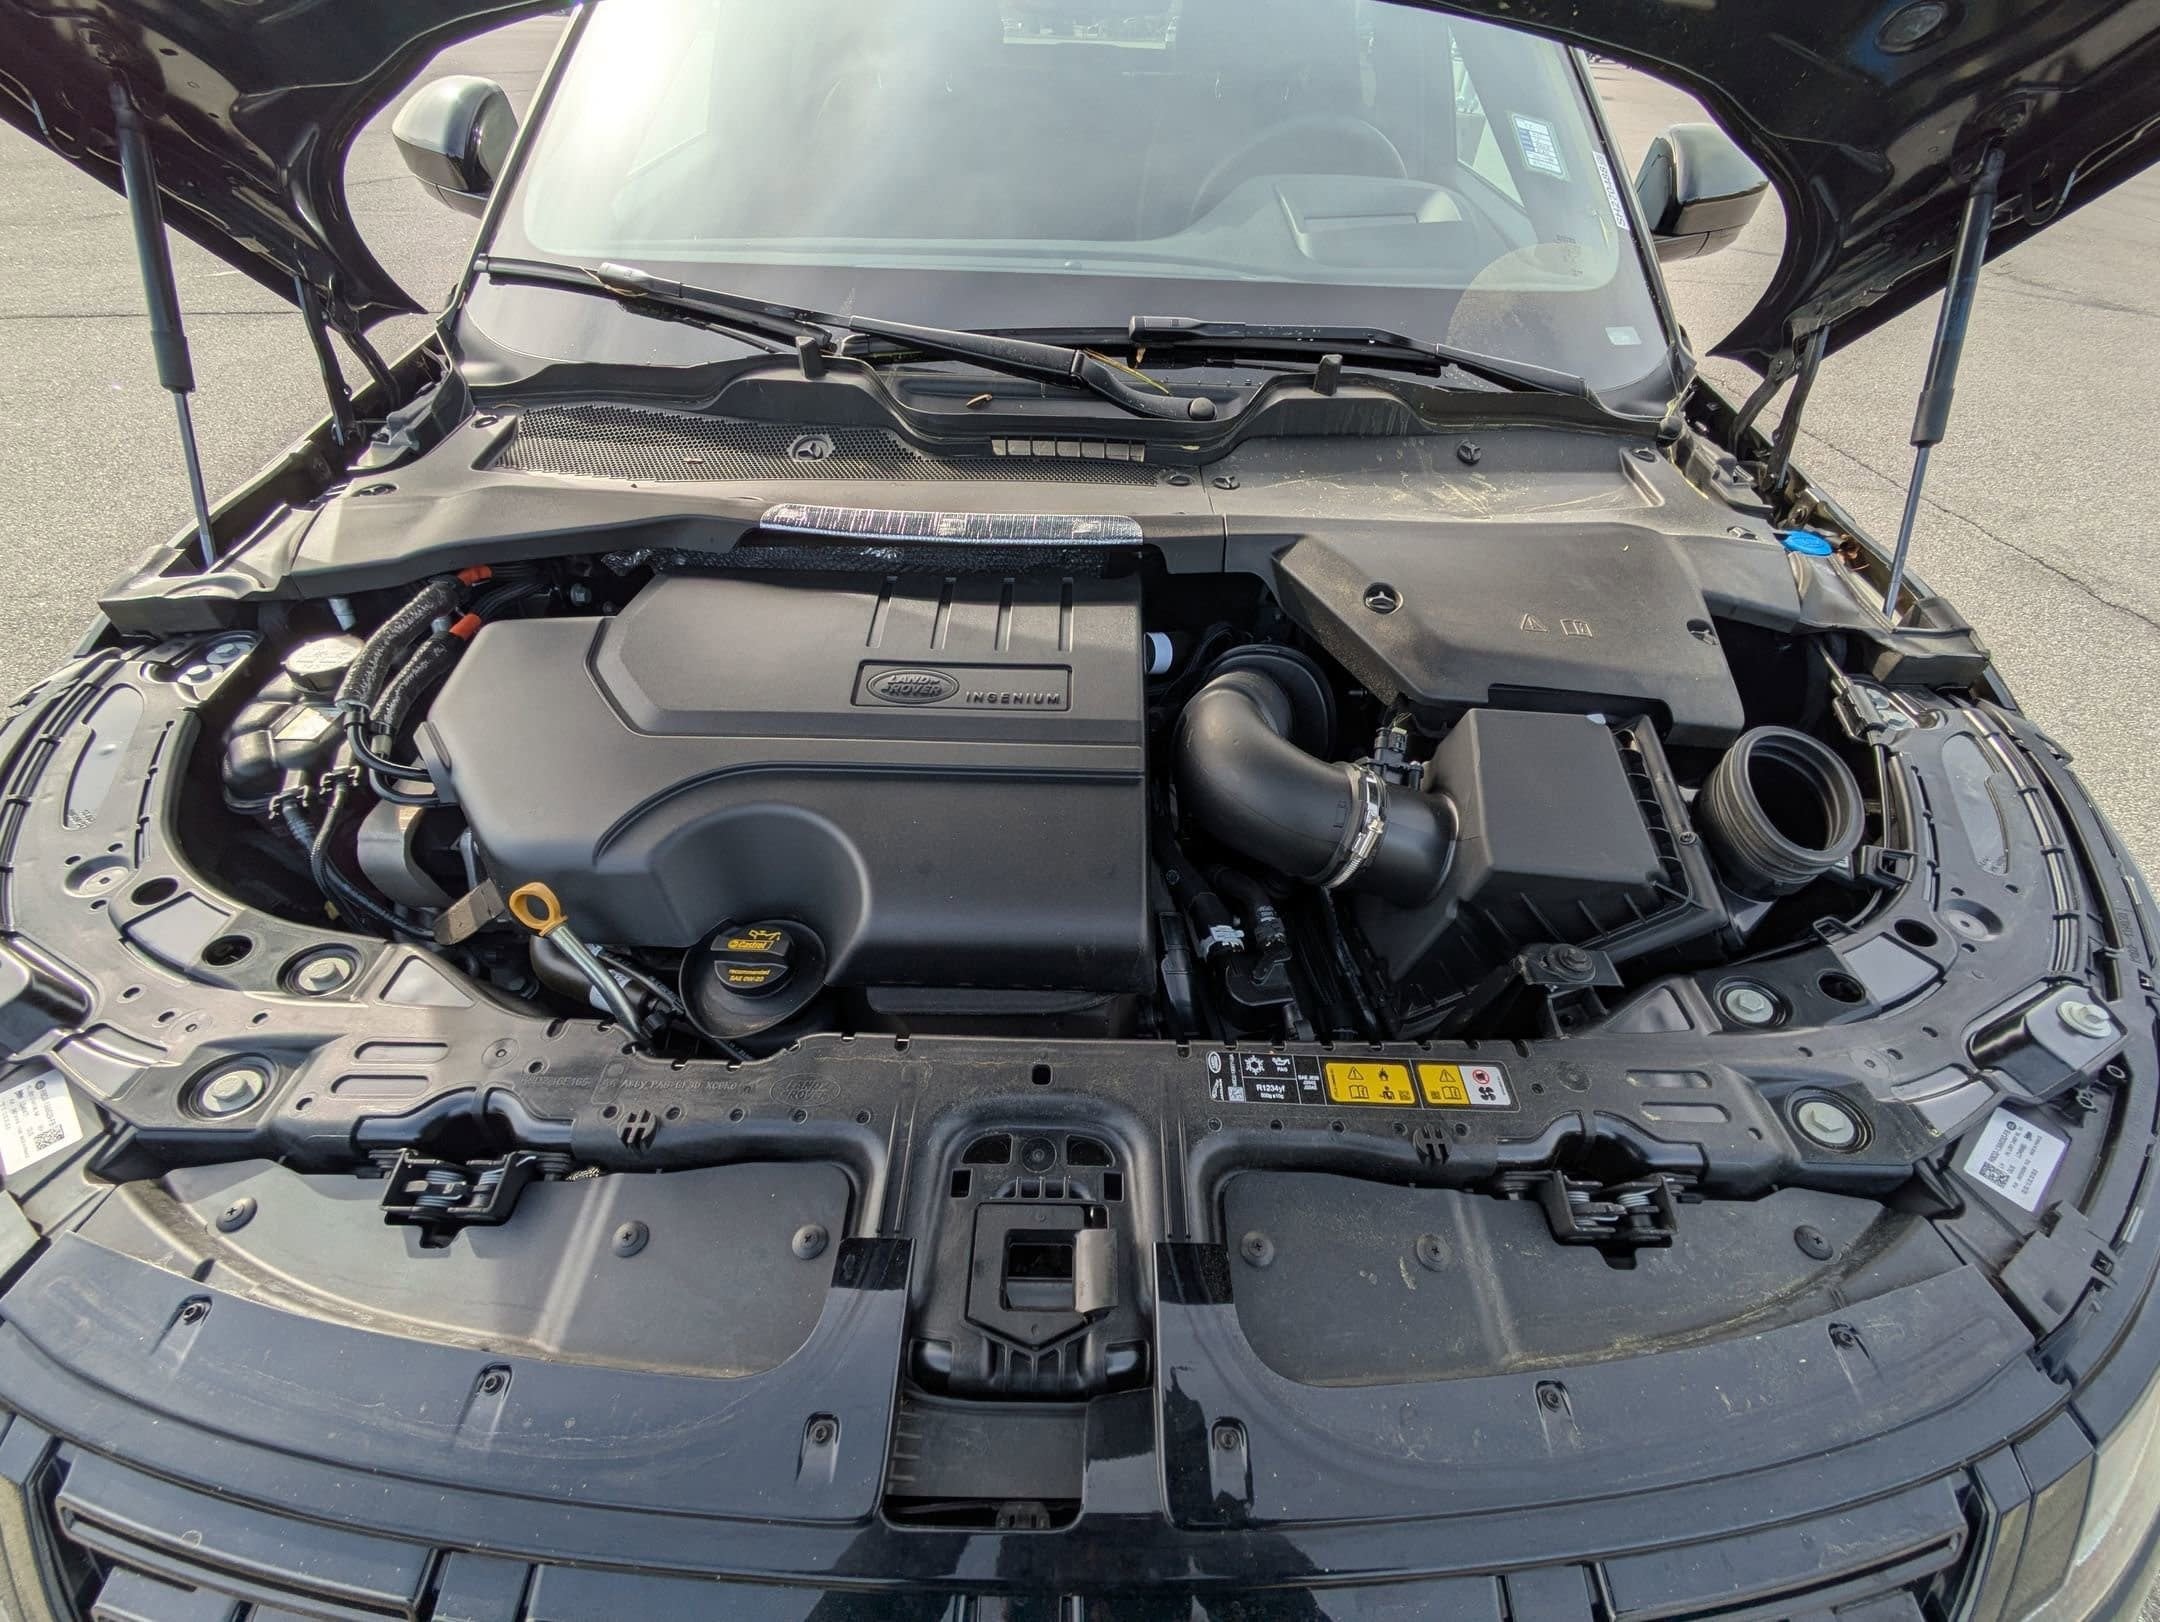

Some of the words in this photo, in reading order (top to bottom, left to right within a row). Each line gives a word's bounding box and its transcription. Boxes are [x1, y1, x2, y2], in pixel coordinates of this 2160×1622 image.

[887, 674, 931, 685] LAND
[888, 683, 943, 697] ROVER
[965, 690, 1061, 705] INGENIUM
[737, 940, 767, 950] Castrol
[1255, 1083, 1286, 1094] R1234yf
